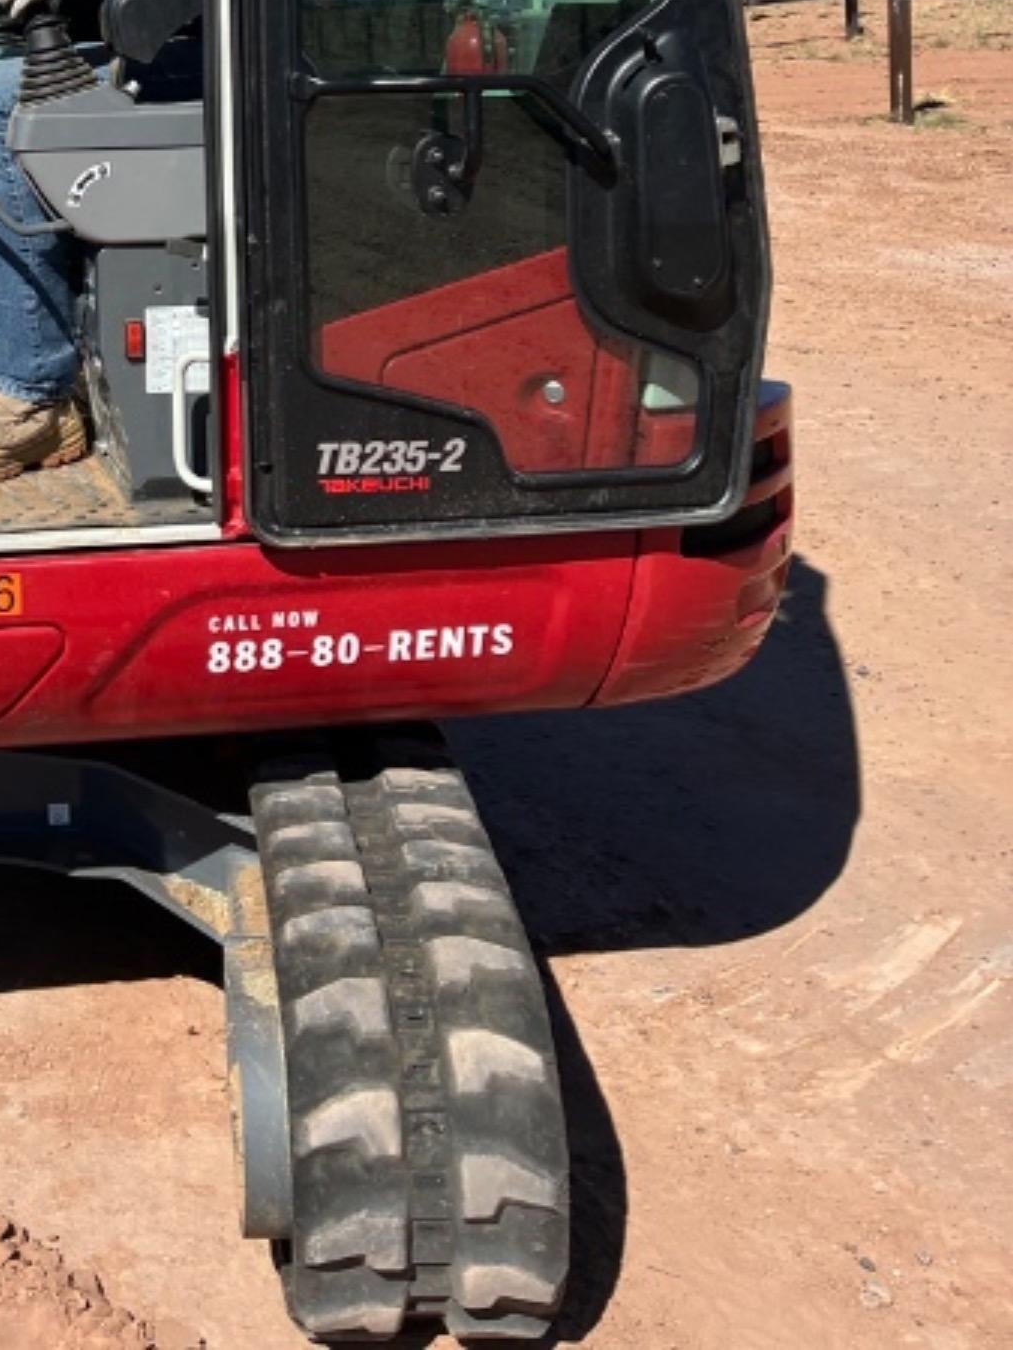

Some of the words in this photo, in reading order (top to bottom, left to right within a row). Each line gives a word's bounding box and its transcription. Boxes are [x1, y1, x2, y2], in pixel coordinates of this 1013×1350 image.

[316, 437, 467, 475] TB235-2
[208, 615, 261, 633] CALL
[272, 610, 320, 629] NOW
[206, 623, 514, 674] 888-80-RENTS
